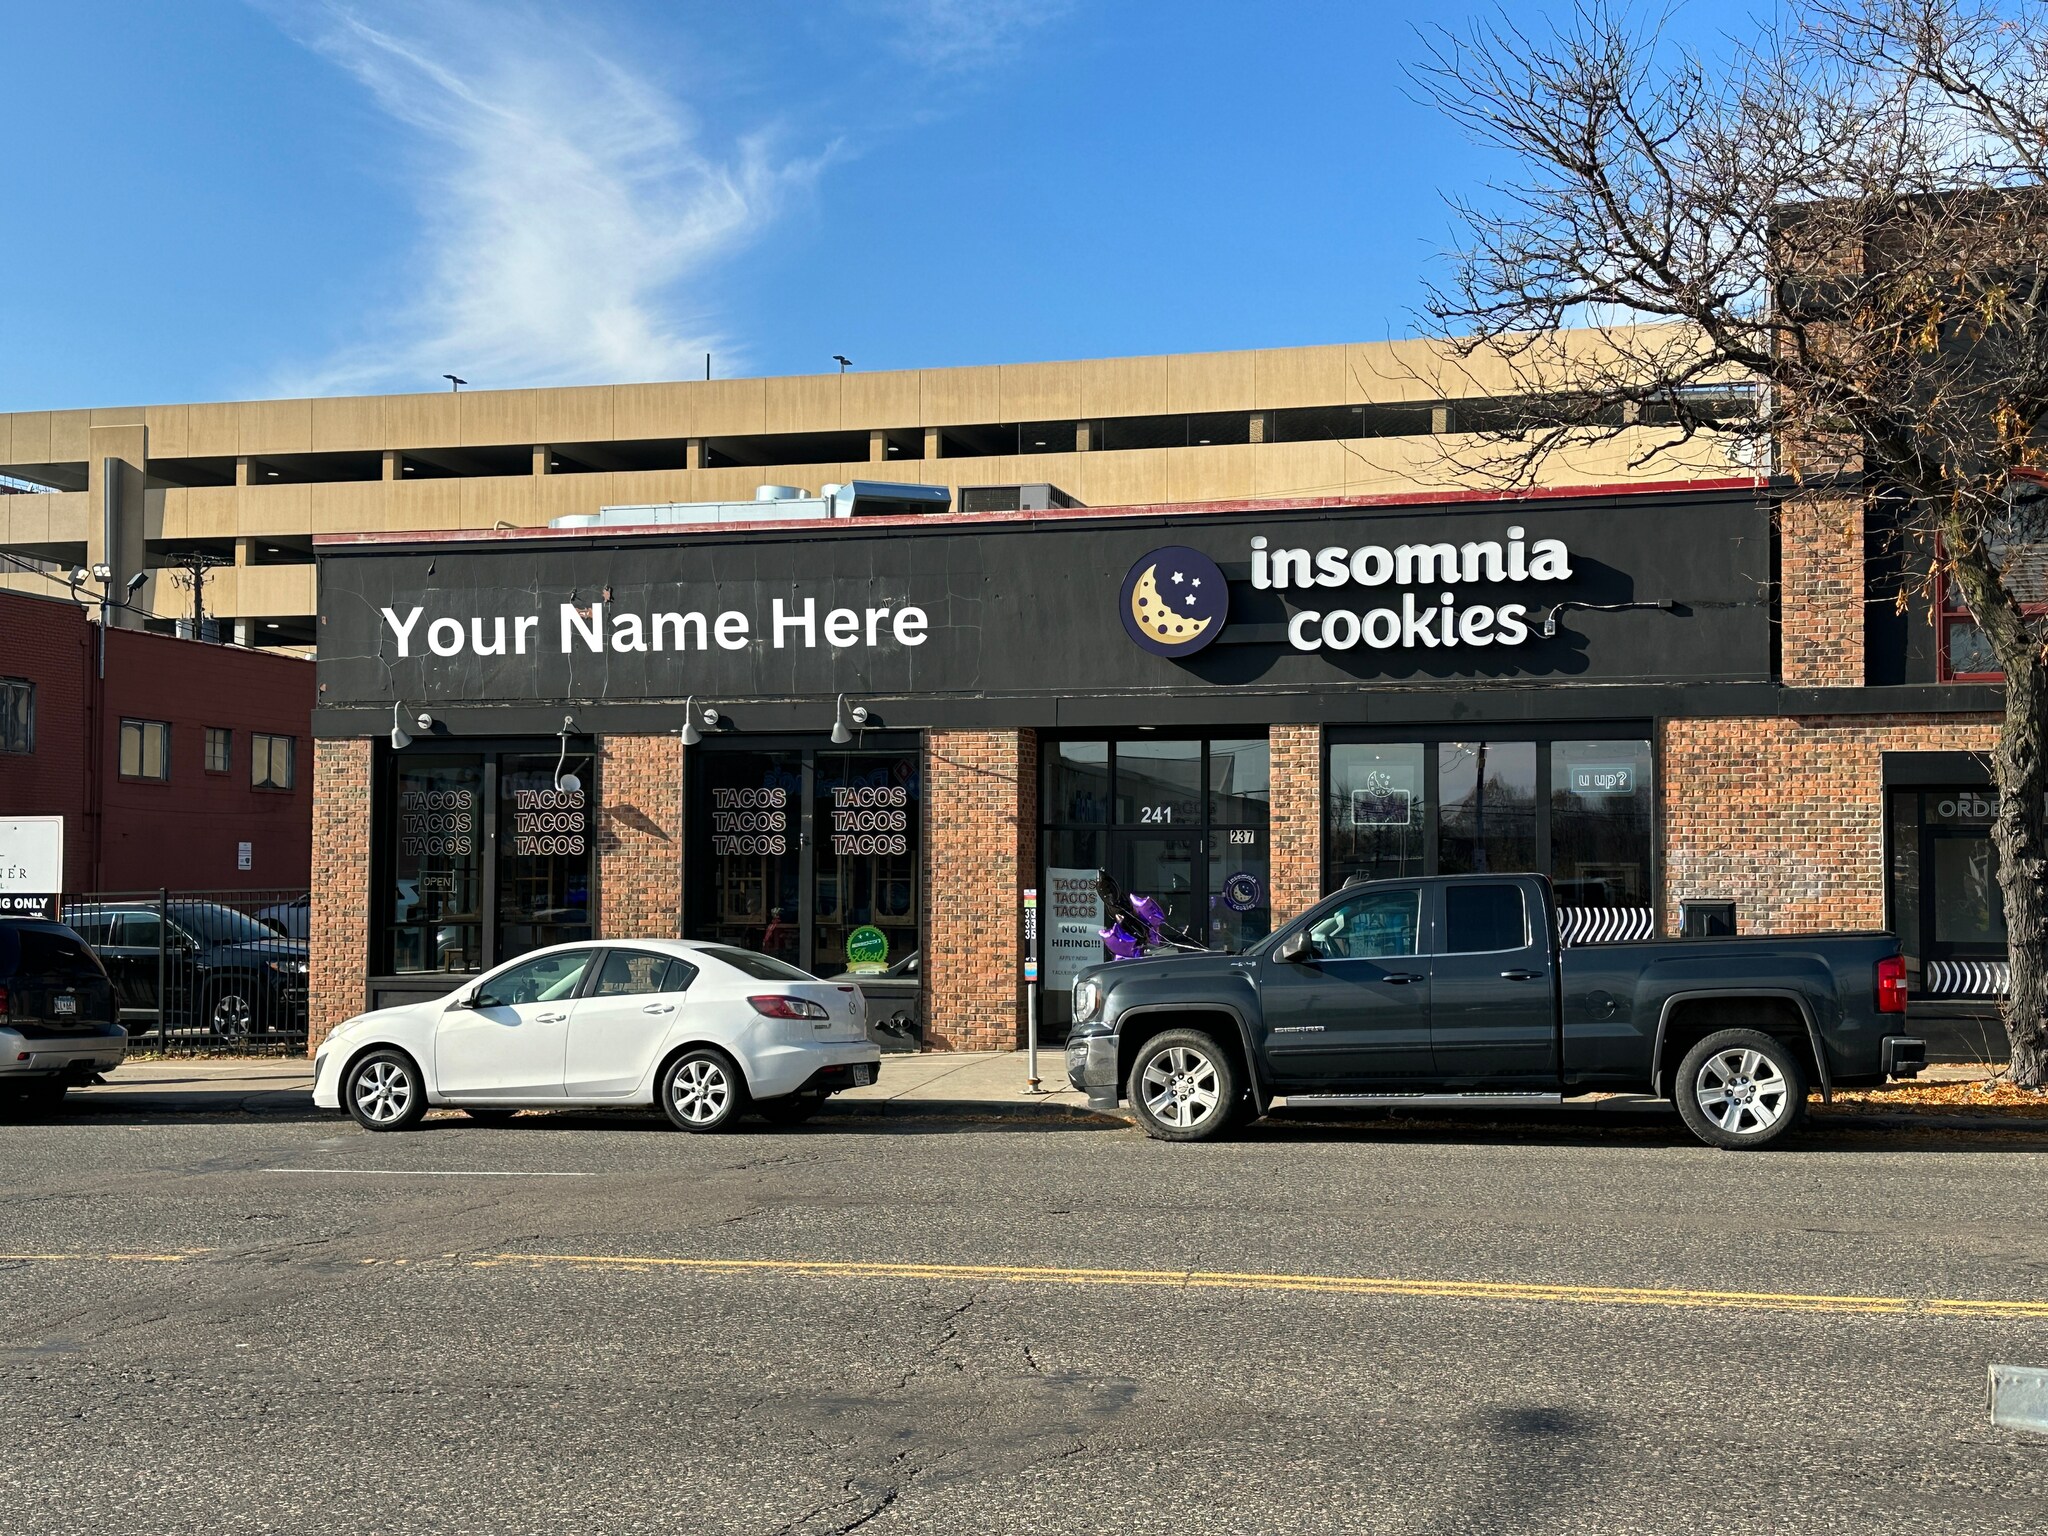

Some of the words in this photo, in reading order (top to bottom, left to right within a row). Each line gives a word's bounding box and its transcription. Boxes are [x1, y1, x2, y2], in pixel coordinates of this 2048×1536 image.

[1250, 525, 1573, 590] insomnia
[1287, 592, 1529, 652] cookies
[1579, 774, 1590, 787] u
[1594, 771, 1628, 790] up?
[402, 790, 472, 811] TACOS
[513, 789, 585, 810] TACOS
[712, 788, 787, 809] TACOS
[831, 786, 907, 808] TACOS
[1141, 806, 1171, 824] 241
[1938, 800, 2000, 818] ORDE
[402, 813, 472, 834] TACOS
[513, 812, 585, 833] TACOS
[712, 811, 787, 832] TACOS
[831, 810, 907, 831] TACOS
[402, 836, 472, 857] TACOS
[513, 835, 585, 856] TACOS
[712, 834, 787, 856] TACOS
[831, 834, 907, 856] TACOS
[1231, 830, 1253, 843] 237
[423, 876, 451, 887] OPEN
[1053, 878, 1097, 891] TACOS
[0, 897, 11, 909] G
[14, 897, 48, 909] ONLY
[1053, 892, 1097, 904] TACOS
[1053, 905, 1097, 918] TACOS
[1062, 925, 1088, 934] NOW
[1052, 939, 1101, 948] HIRING!!!
